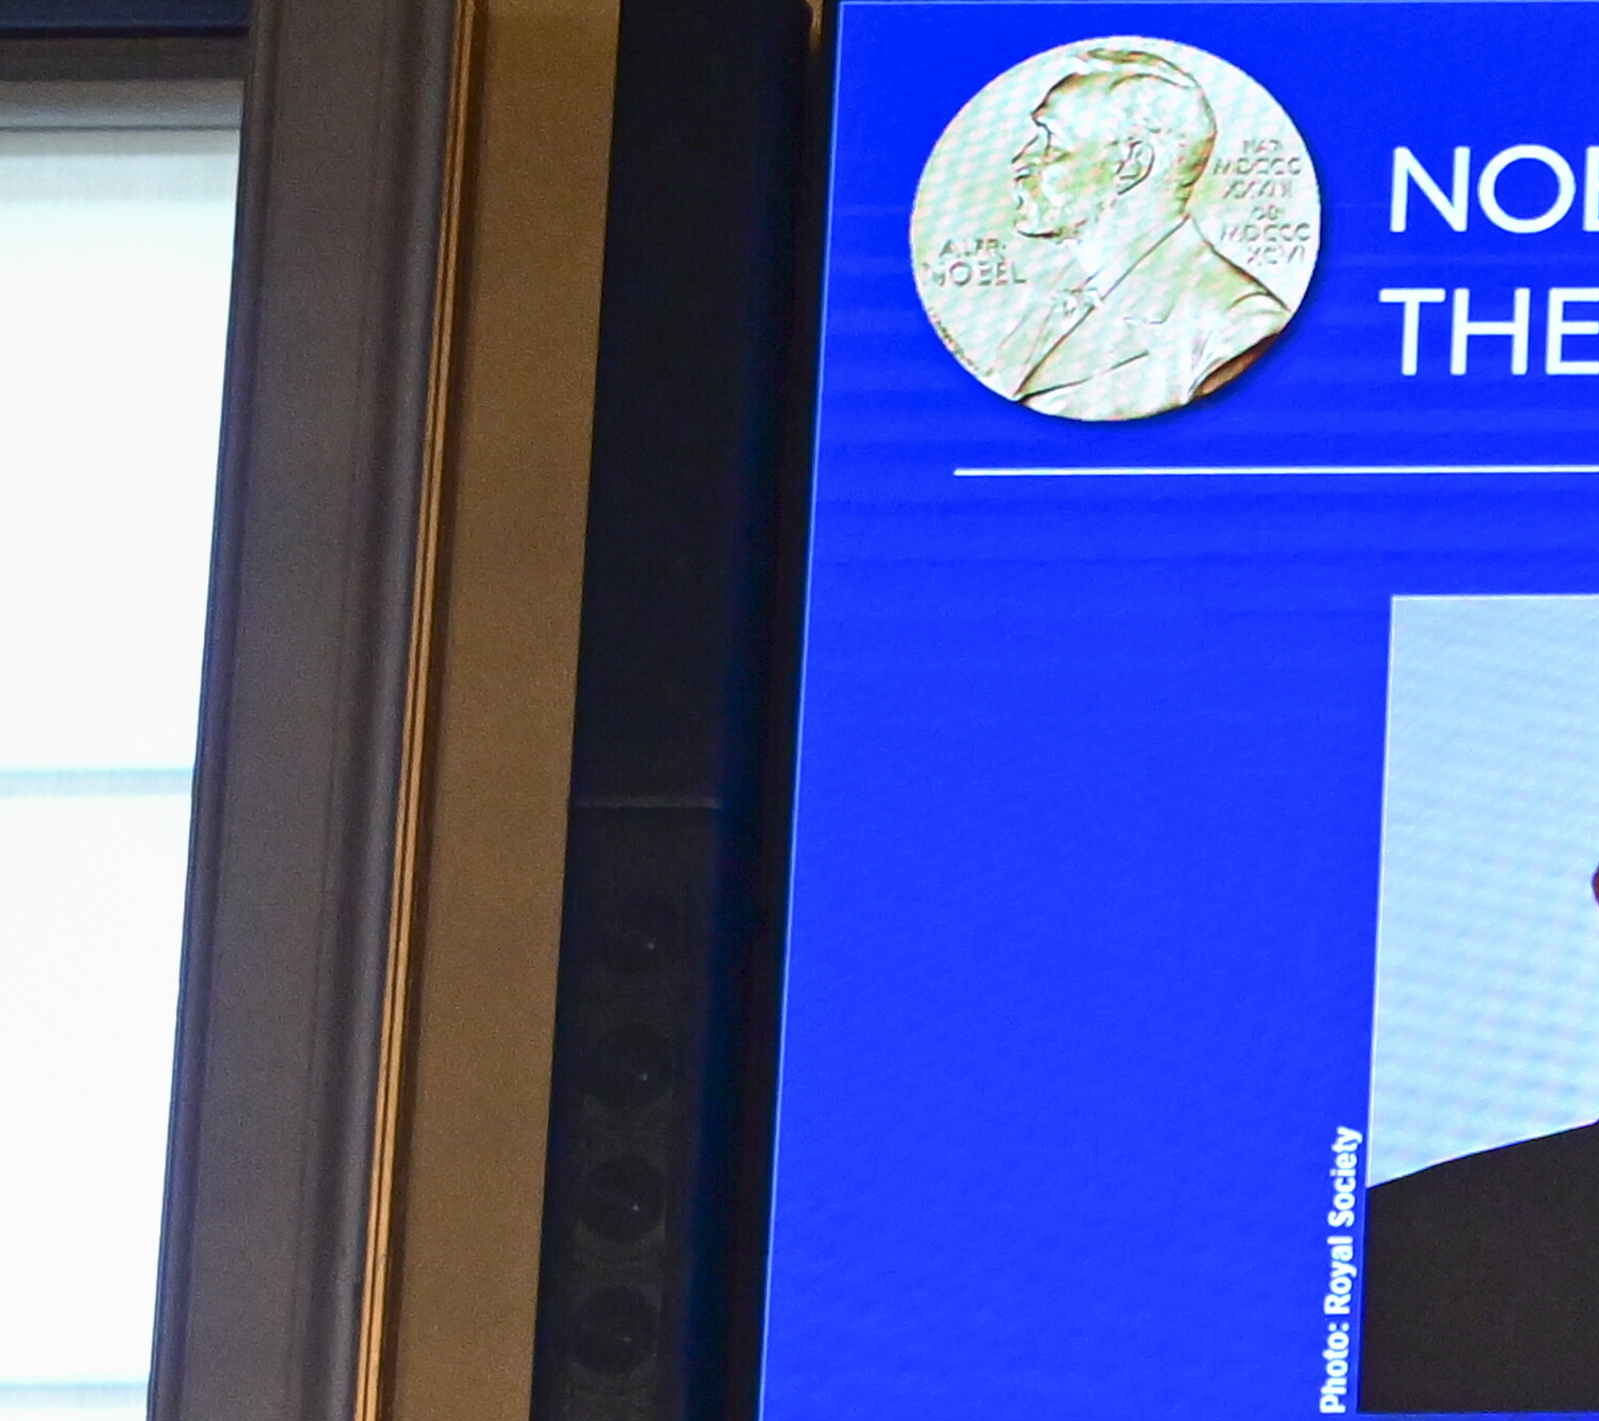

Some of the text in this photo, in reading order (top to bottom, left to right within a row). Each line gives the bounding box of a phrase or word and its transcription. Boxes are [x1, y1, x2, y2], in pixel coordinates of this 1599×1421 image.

[1318, 1125, 1364, 1415] Photo: Royal Society
